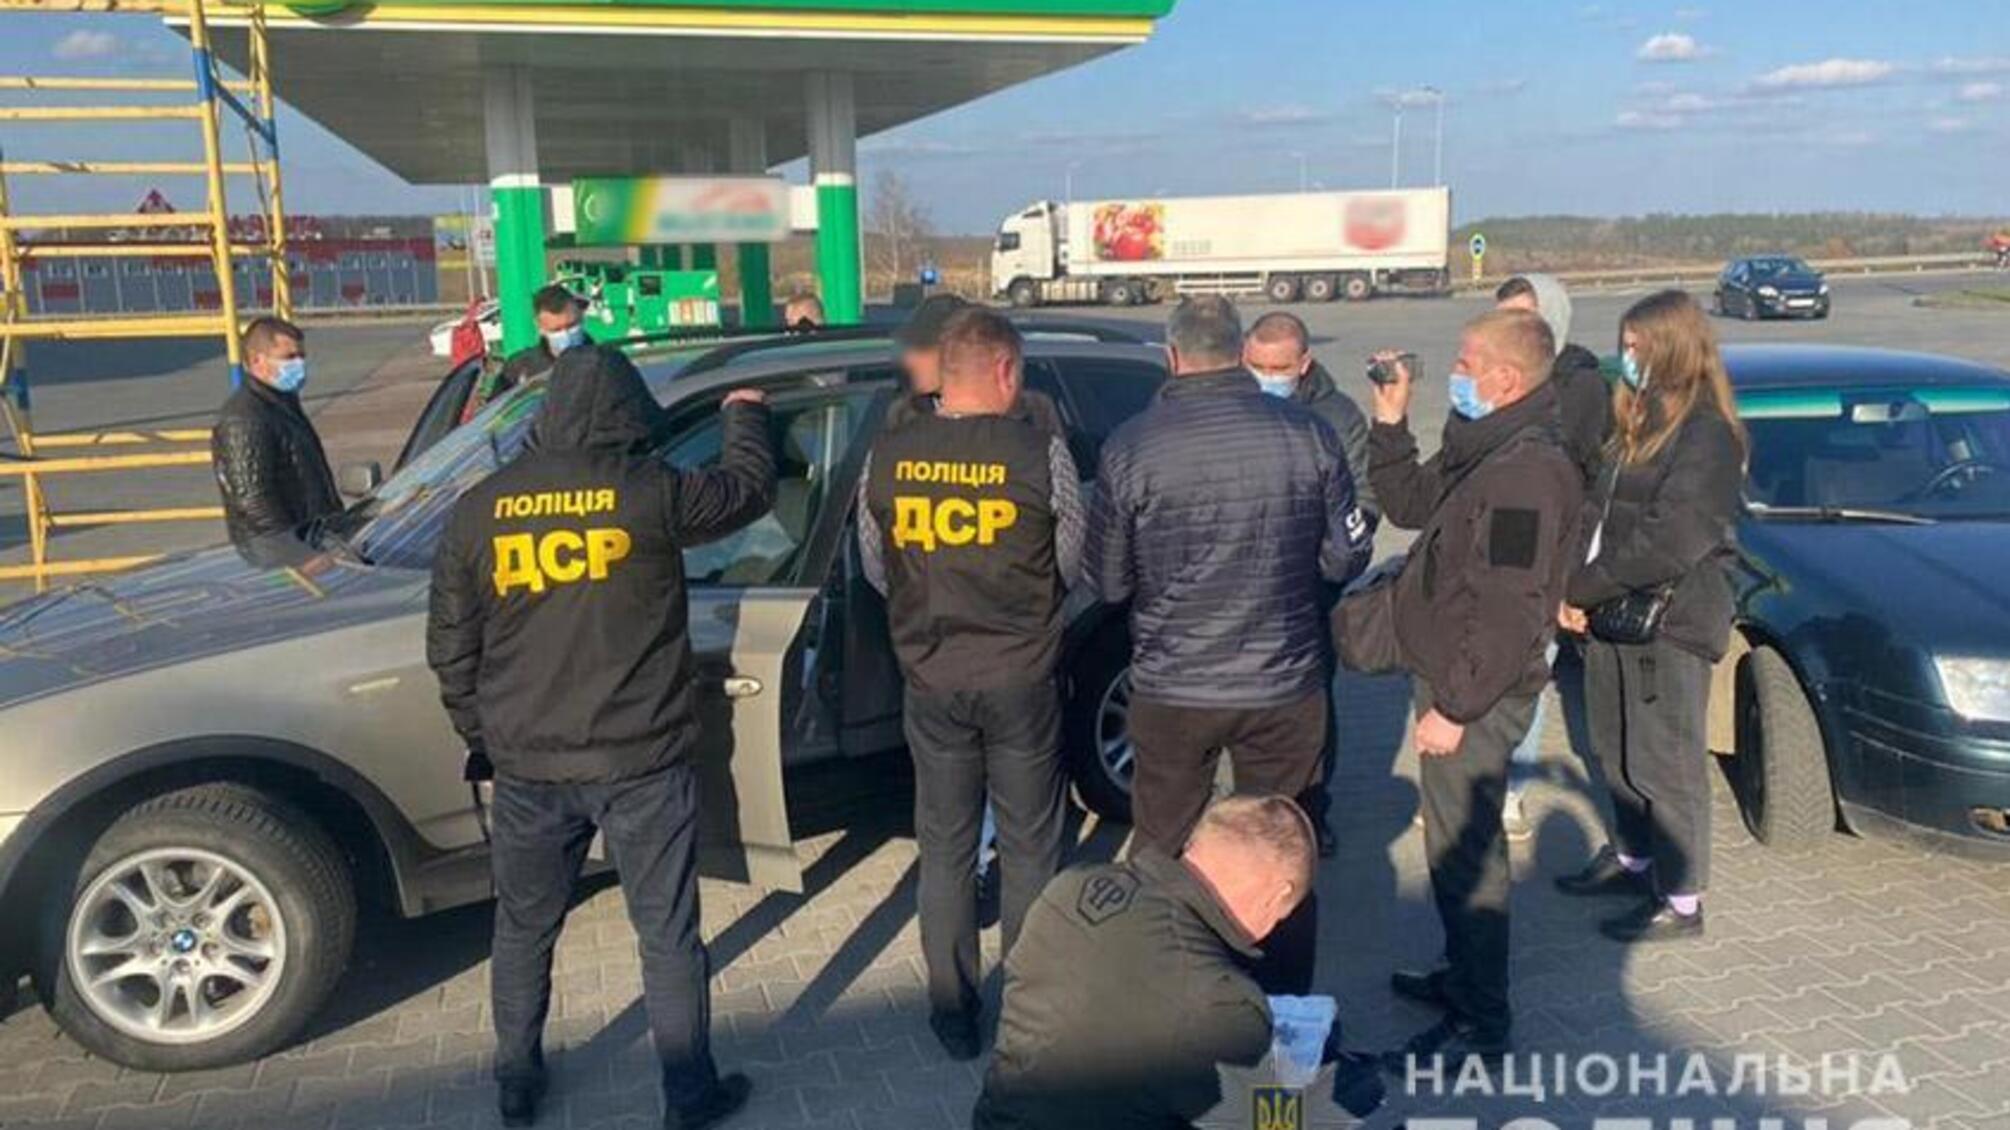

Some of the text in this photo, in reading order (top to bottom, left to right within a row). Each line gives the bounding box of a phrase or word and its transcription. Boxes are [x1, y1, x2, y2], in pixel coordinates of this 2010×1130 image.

[895, 460, 1006, 487] ПОЛІЦІЯ
[494, 488, 615, 519] ПОЛІЦІЯ
[892, 497, 1018, 552] ДСР
[493, 528, 632, 596] ДСР
